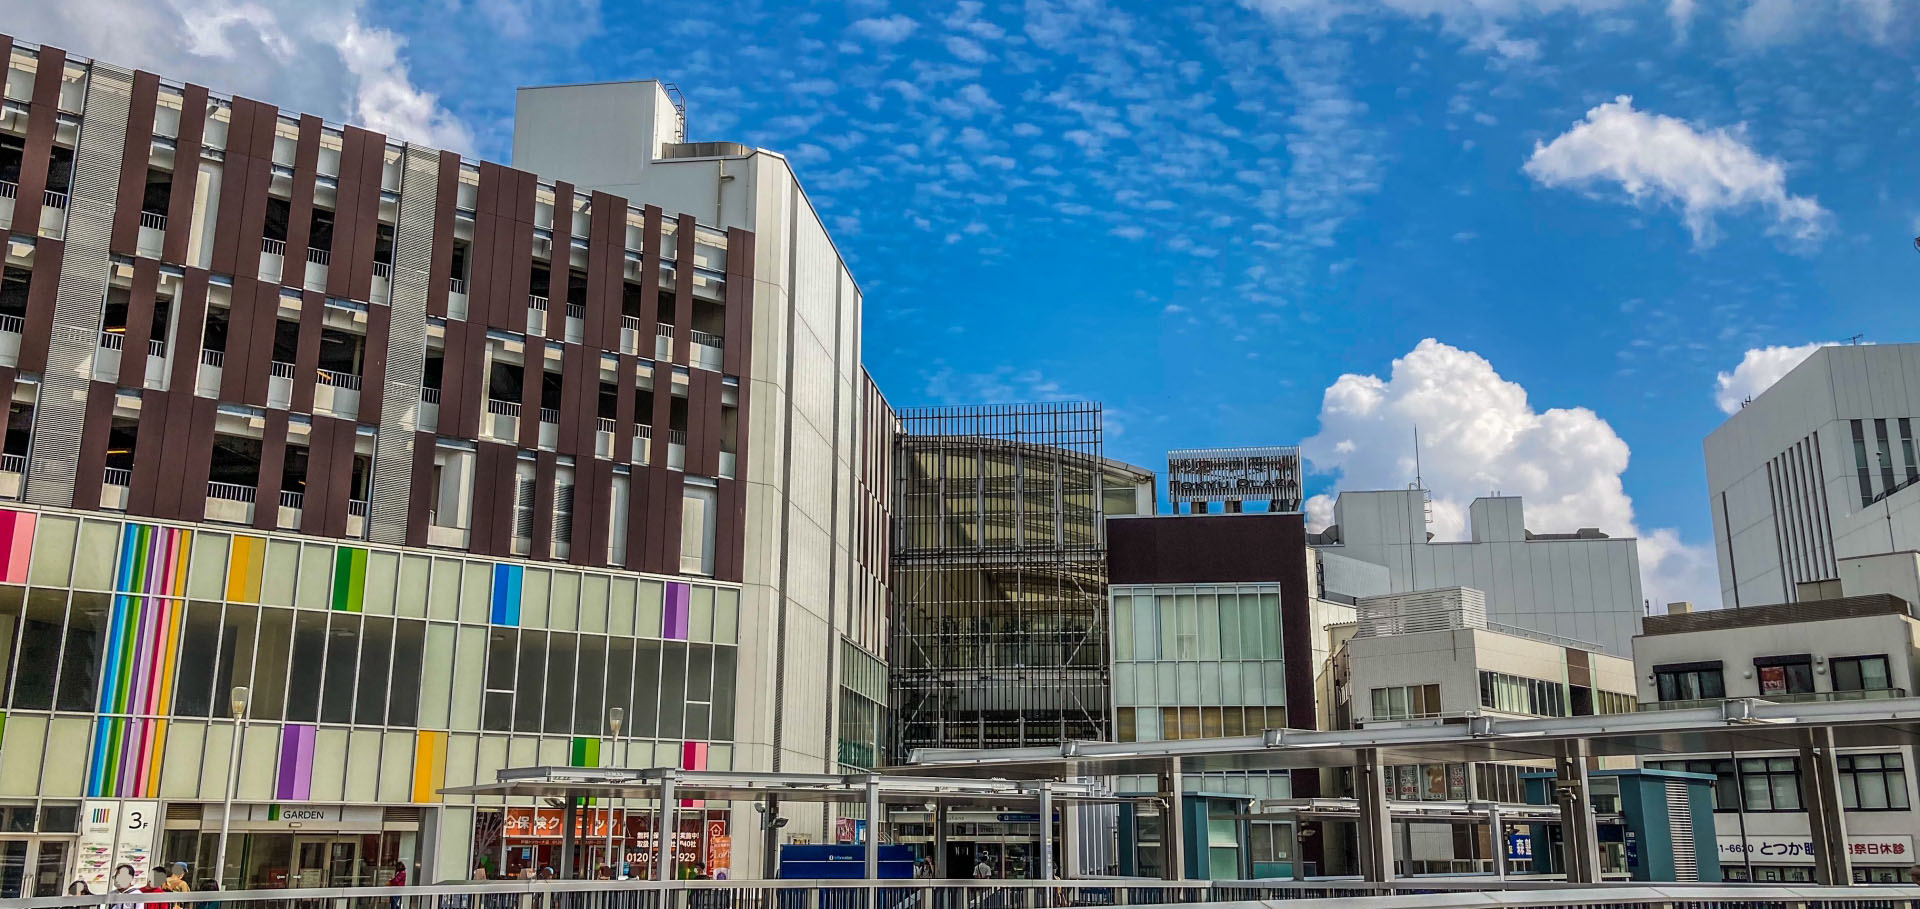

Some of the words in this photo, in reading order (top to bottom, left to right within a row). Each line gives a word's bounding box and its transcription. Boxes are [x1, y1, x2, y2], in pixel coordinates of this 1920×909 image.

[1170, 479, 1229, 491] TOKYU
[1237, 479, 1298, 488] PLAZA
[283, 810, 324, 819] GARDEN
